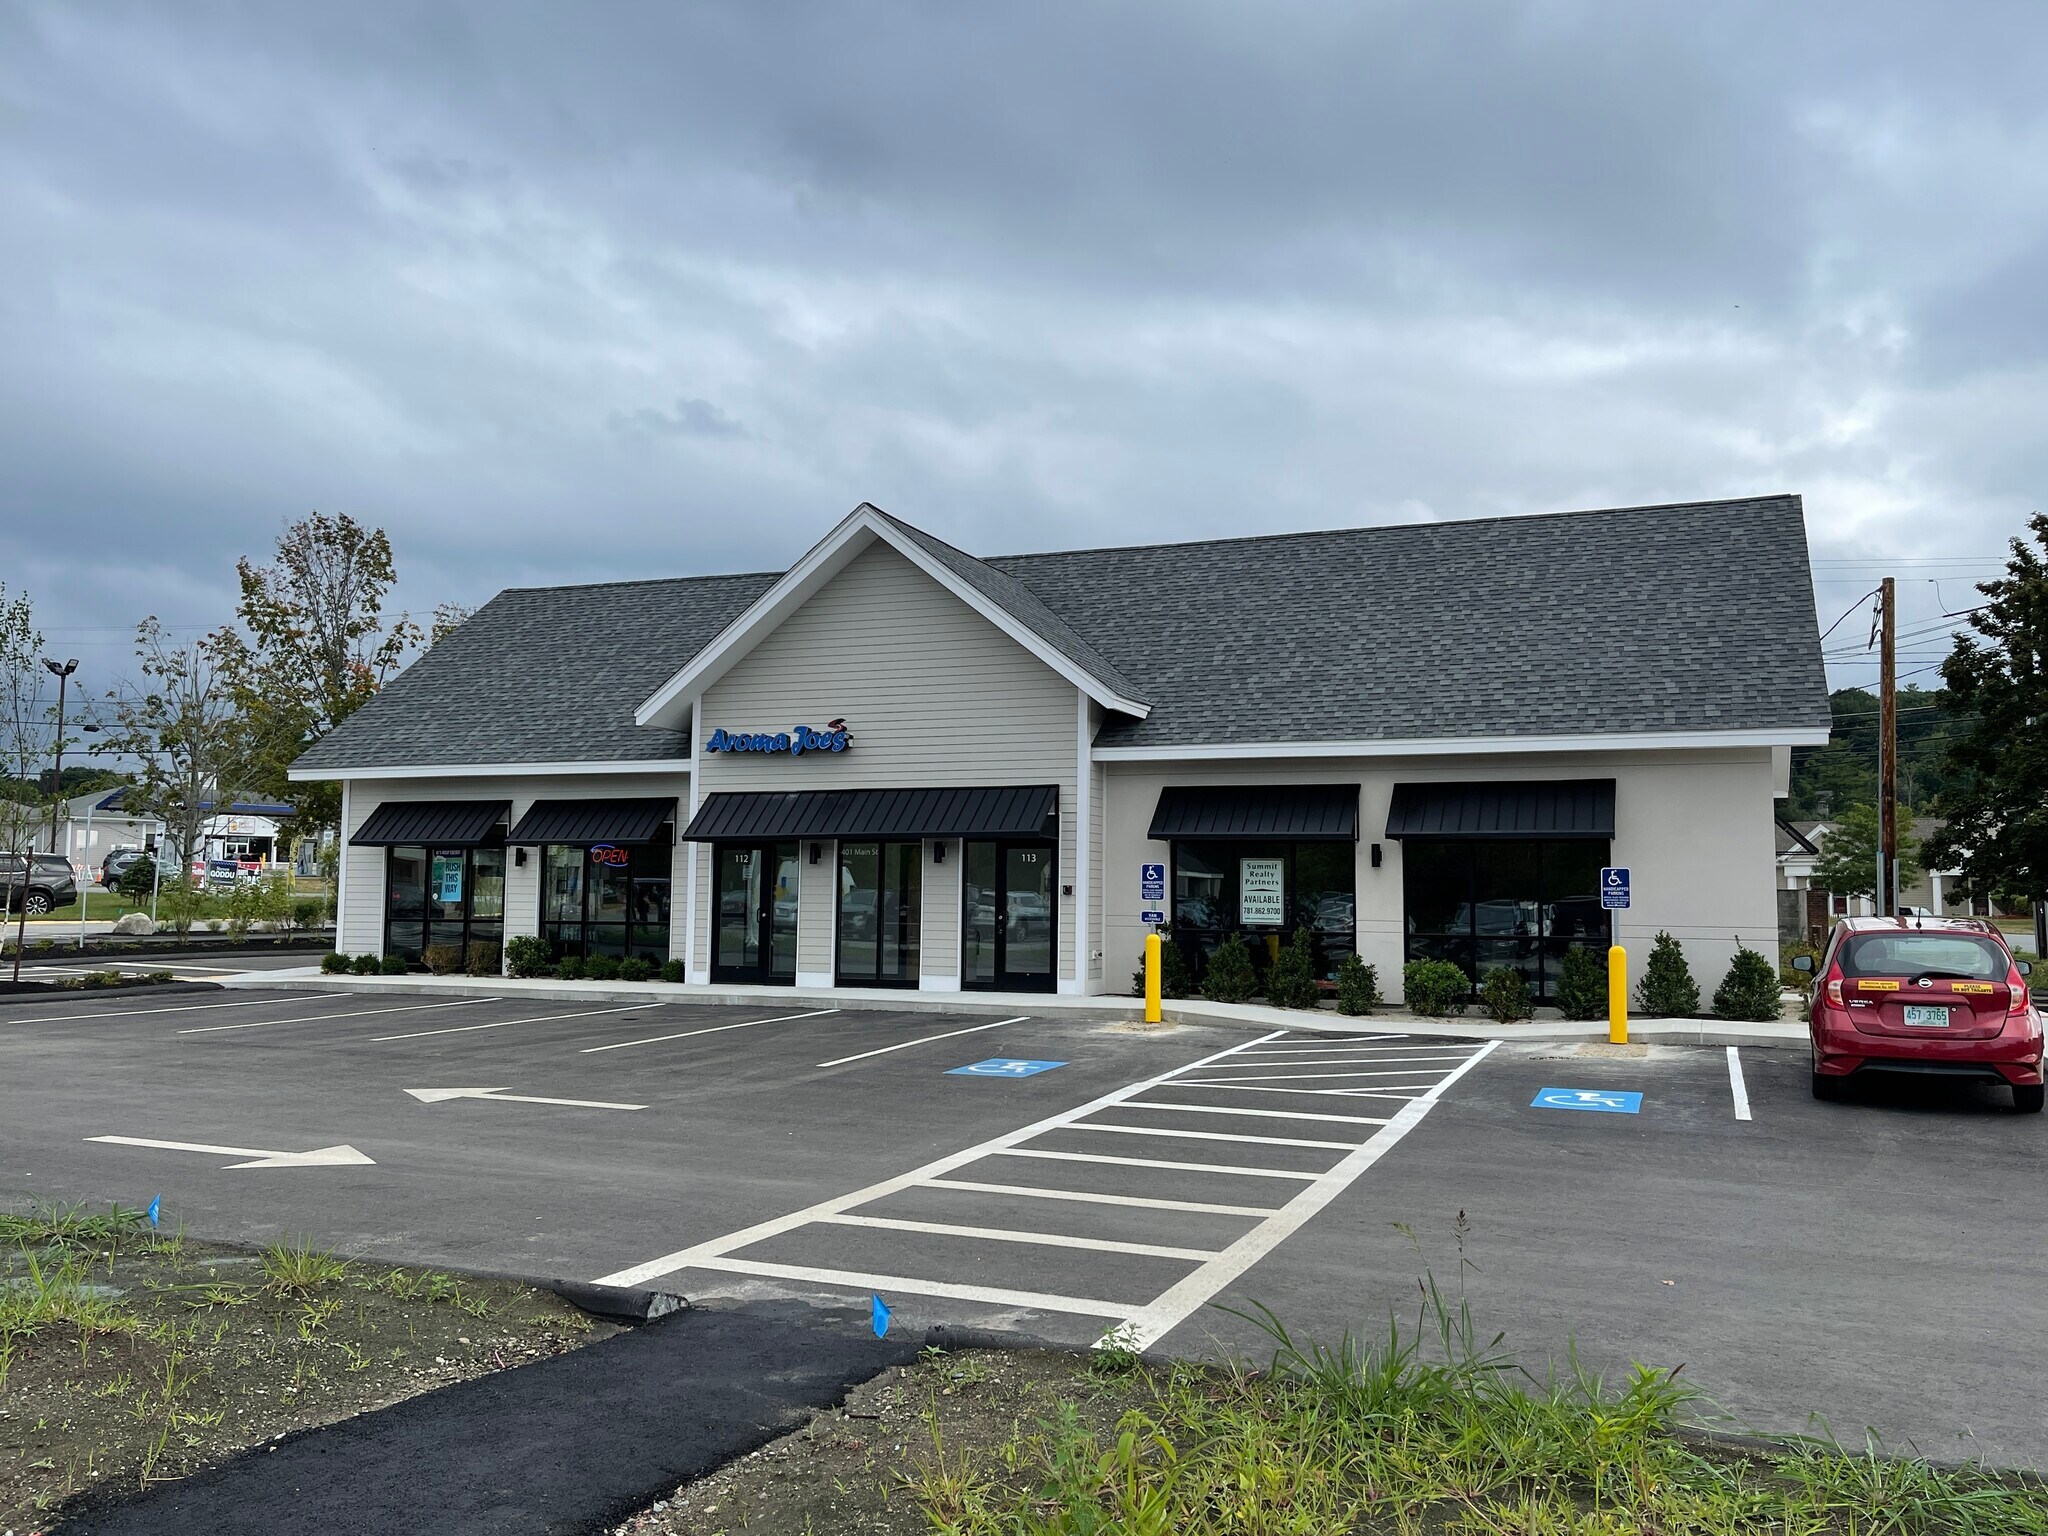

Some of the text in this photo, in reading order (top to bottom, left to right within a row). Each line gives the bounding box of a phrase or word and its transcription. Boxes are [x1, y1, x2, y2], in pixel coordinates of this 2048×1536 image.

[705, 728, 791, 753] Aroma
[592, 849, 628, 863] OPEN
[854, 848, 871, 856] Main
[735, 855, 749, 863] 112
[1021, 853, 1037, 863] 113
[445, 862, 461, 872] RUSH
[210, 870, 235, 879] GODDU
[445, 873, 459, 883] THIS
[1249, 870, 1275, 879] Realty
[1245, 878, 1279, 886] Partners
[445, 883, 458, 893] WAY
[1243, 895, 1280, 904] AVAILABLE
[1243, 907, 1281, 915] 781.862.9700
[1906, 1010, 1947, 1021] 457 3765
